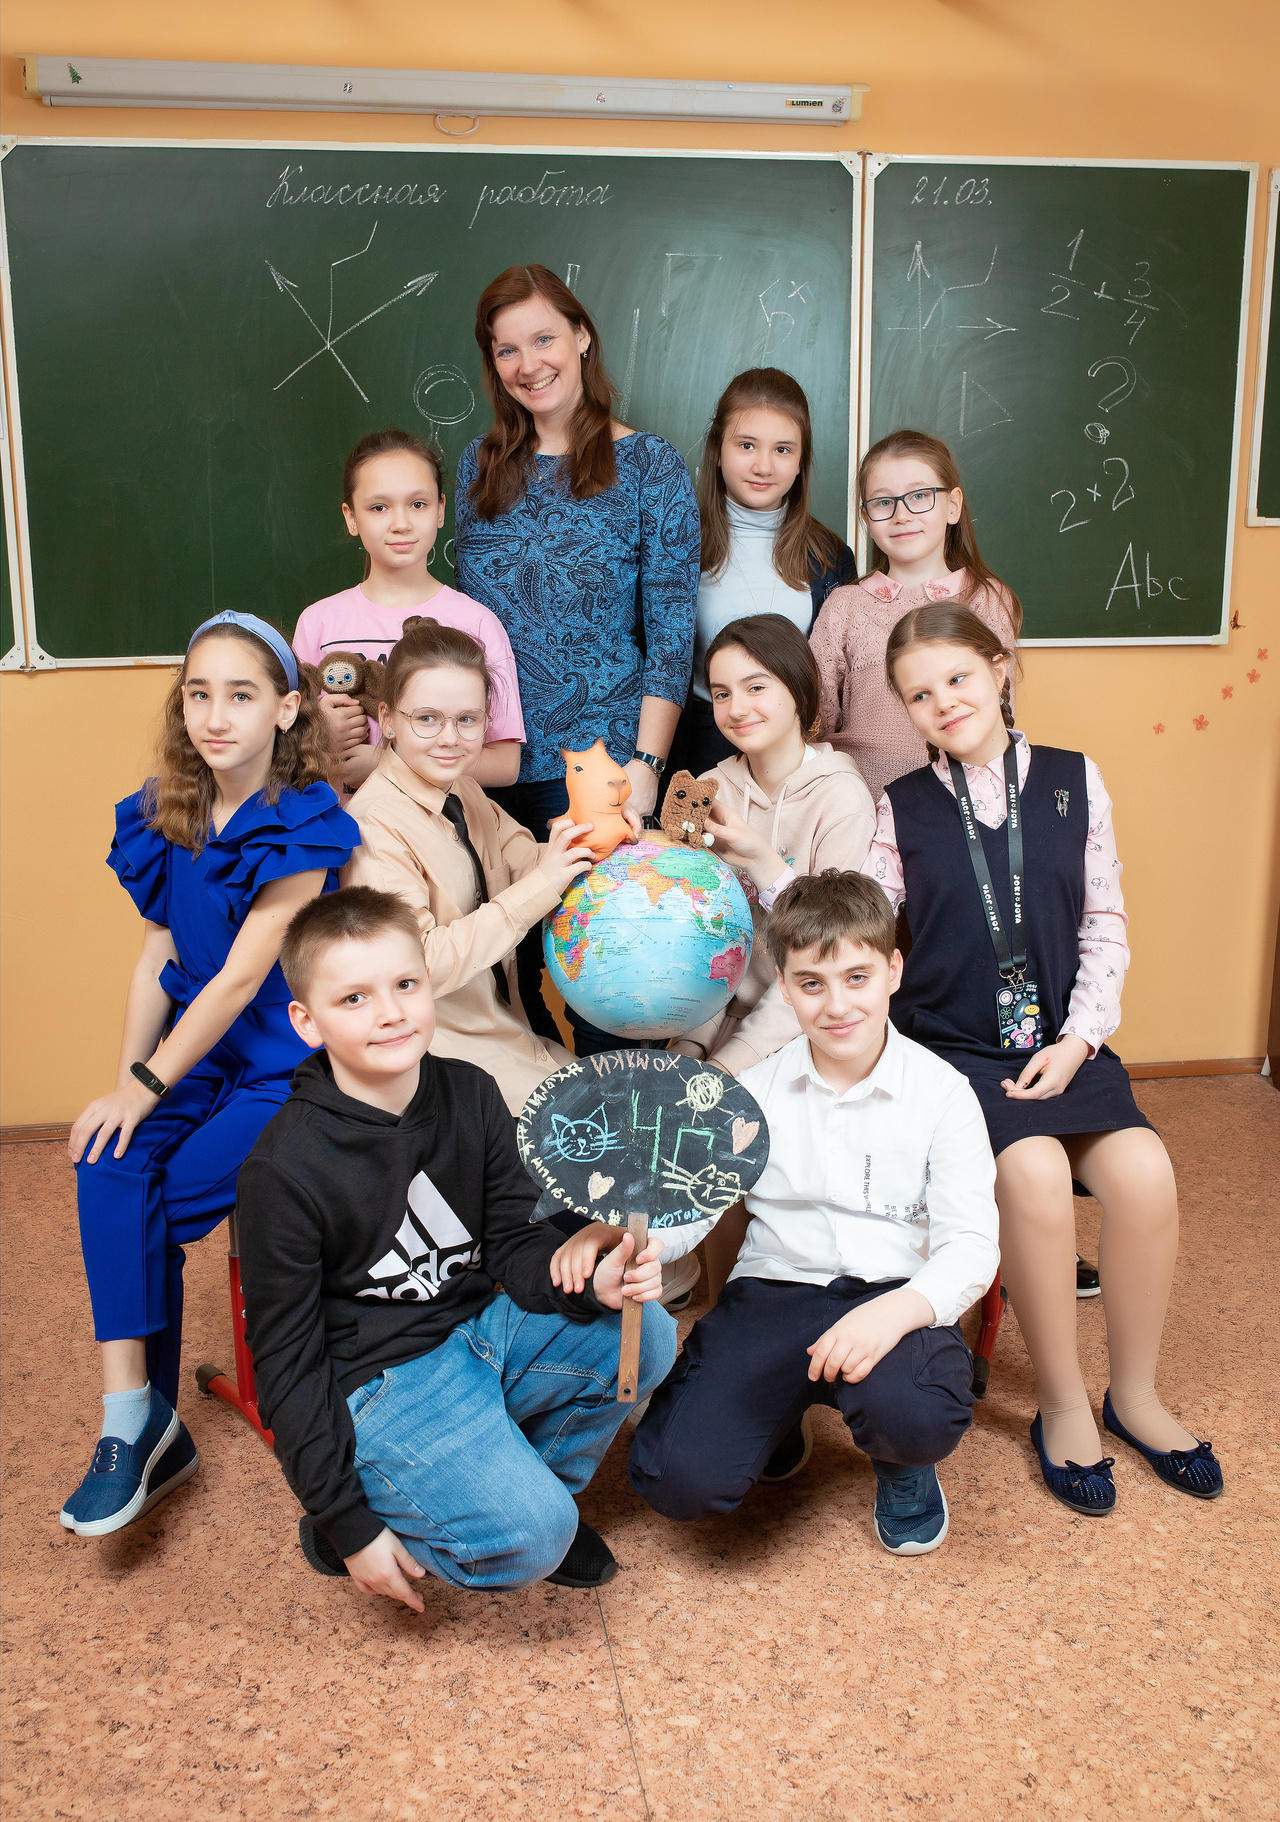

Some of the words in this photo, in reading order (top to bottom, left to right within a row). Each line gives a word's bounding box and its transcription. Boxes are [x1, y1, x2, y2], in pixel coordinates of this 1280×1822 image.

[791, 99, 823, 107] Lumien
[265, 164, 448, 208] Классная
[468, 169, 615, 230] работа
[911, 175, 993, 206] 21.03.
[1105, 541, 1190, 611] Abc
[1008, 783, 1017, 803] JOKI
[960, 796, 970, 816] JOYA
[1010, 808, 1018, 829] JOYA
[966, 821, 976, 840] JOKI
[982, 883, 993, 905] JOYA
[1013, 874, 1021, 896] JOKI
[989, 911, 1000, 932] JOKI
[1014, 902, 1022, 924] JOYA
